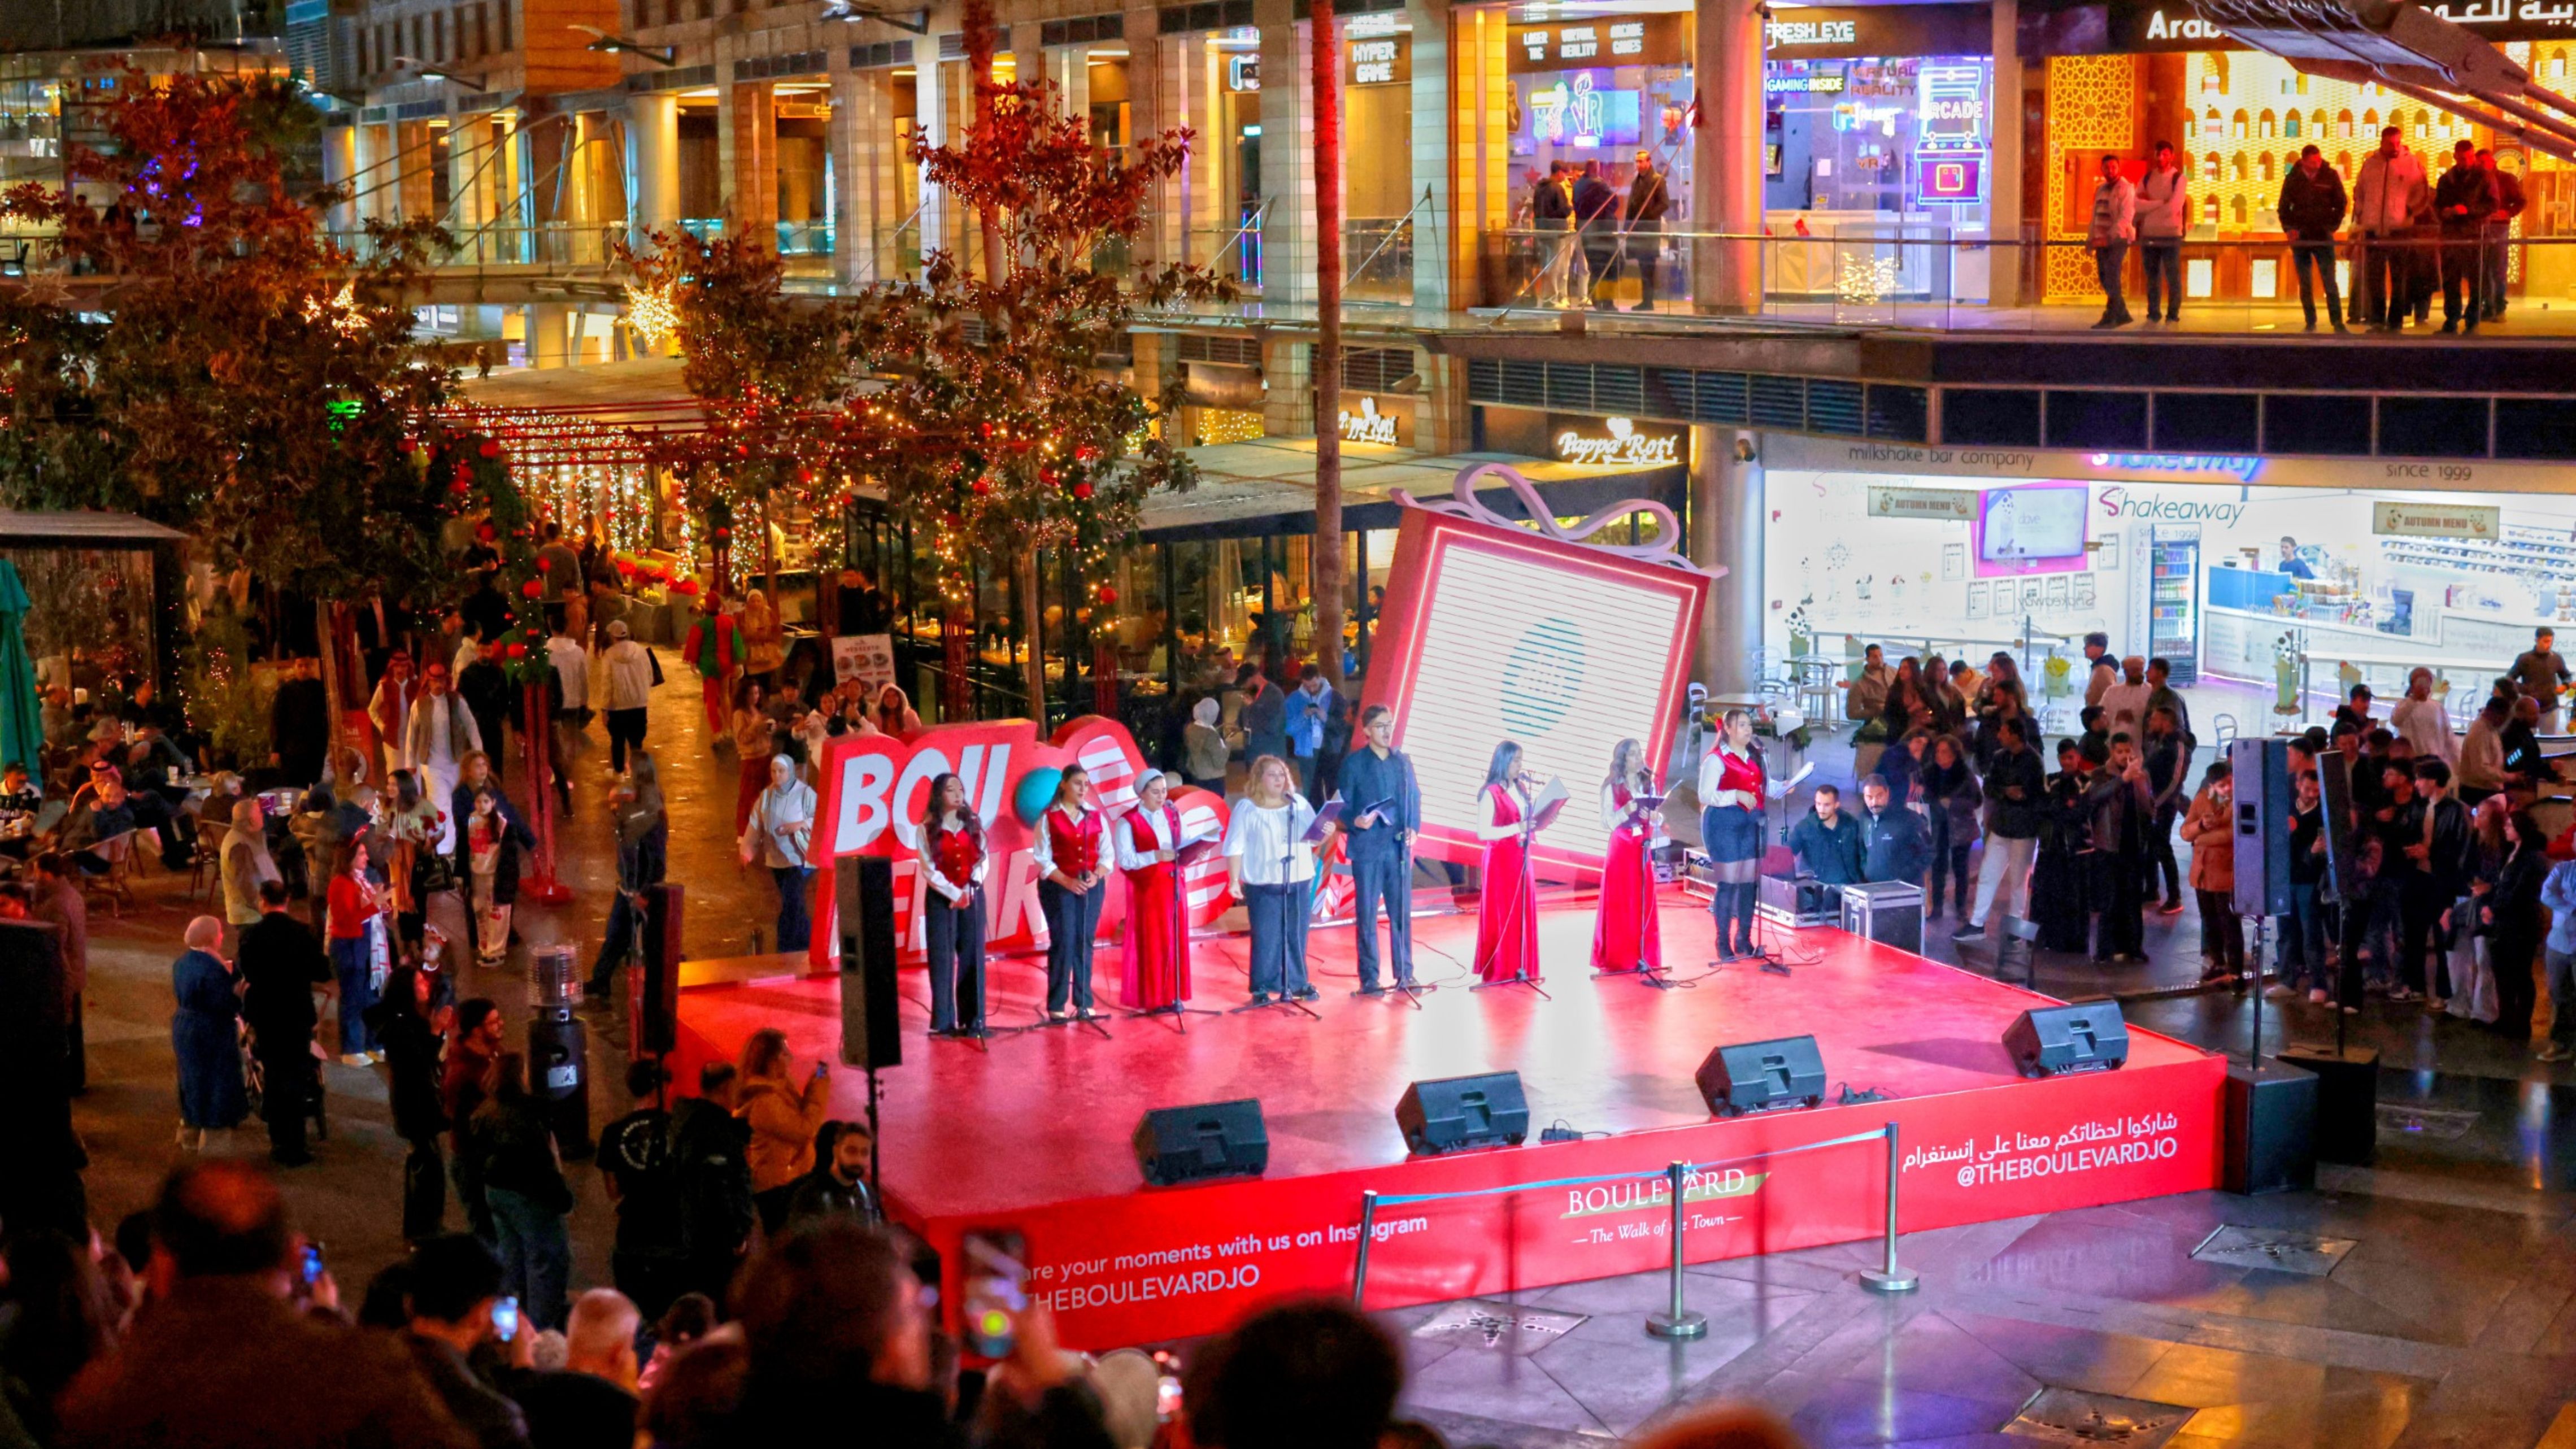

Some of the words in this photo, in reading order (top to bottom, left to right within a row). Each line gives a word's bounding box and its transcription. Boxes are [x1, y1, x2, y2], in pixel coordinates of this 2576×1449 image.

[1765, 22, 1817, 39] FRESH
[1821, 20, 1855, 39] EYE
[2146, 10, 2231, 40] Arab
[1352, 41, 1396, 63] HYPER
[1767, 78, 1808, 92] GAMING
[1808, 77, 1844, 92] INSIDE
[1852, 66, 1917, 77] VIRTUAL
[1851, 85, 1917, 97] REALITY
[1558, 432, 1621, 463] Pappa
[1626, 433, 1679, 456] Roti
[1849, 444, 1923, 463] milkshake
[1930, 449, 1954, 463] bar
[1960, 451, 2034, 471] company
[2386, 464, 2429, 478] since
[2438, 465, 2473, 481] 1999
[1894, 499, 1927, 510] AUTUMN
[1929, 501, 1951, 511] MENU
[2099, 487, 2246, 529] Shakeaway
[2404, 516, 2441, 528] AUTUMN
[2442, 518, 2468, 529] MENU
[2055, 1117, 2123, 1151] لحظاتكم
[2127, 1112, 2178, 1138] شاركوا
[1979, 1134, 2011, 1161] على
[2016, 1132, 2051, 1150] معنا
[1902, 1138, 1974, 1173] إنستغرام
[1957, 1137, 2178, 1187] @THEBOULEVARDJO
[1568, 1168, 1746, 1215] BOULEARD
[1590, 1228, 1613, 1244] The
[1617, 1221, 1650, 1239] Walk
[1653, 1219, 1668, 1237] of
[1691, 1214, 1725, 1230] Town
[1023, 1265, 1054, 1281] are
[1060, 1258, 1108, 1283] your
[1114, 1242, 1212, 1270] moments
[1217, 1233, 1261, 1257] with
[1268, 1235, 1291, 1251] us
[1296, 1230, 1322, 1247] on
[1029, 1264, 1260, 1312] HEBOULEVARDJO
